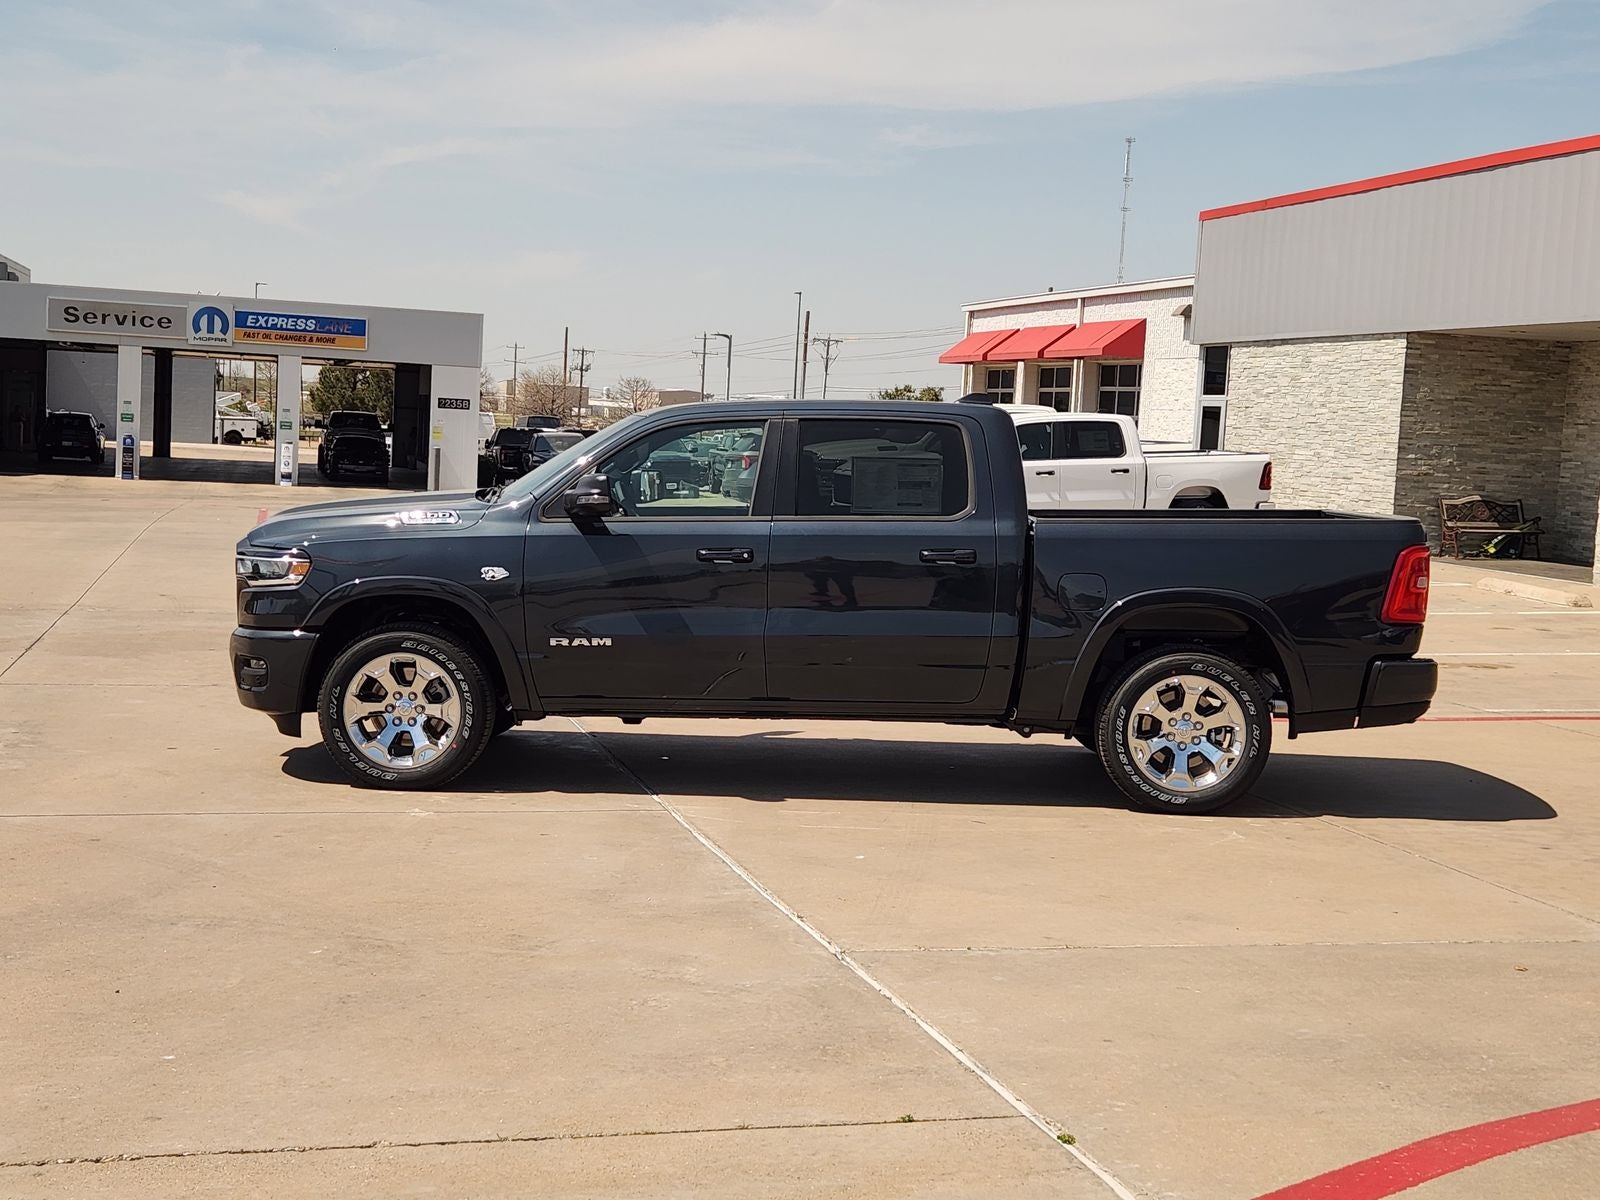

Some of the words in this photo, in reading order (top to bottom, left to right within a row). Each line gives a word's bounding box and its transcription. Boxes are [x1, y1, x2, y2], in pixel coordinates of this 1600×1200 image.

[63, 306, 173, 329] Service
[242, 331, 260, 340] FAST
[262, 333, 273, 341] OIL
[274, 334, 307, 343] CHANGES
[315, 337, 337, 345] MORE
[439, 399, 469, 409] 2235B
[549, 637, 612, 646] RAM
[401, 640, 474, 740] BRIDGESTONE
[1191, 663, 1258, 716] DUELER
[333, 727, 398, 781] DUELER
[1116, 706, 1188, 805] BRIDGESTONE
